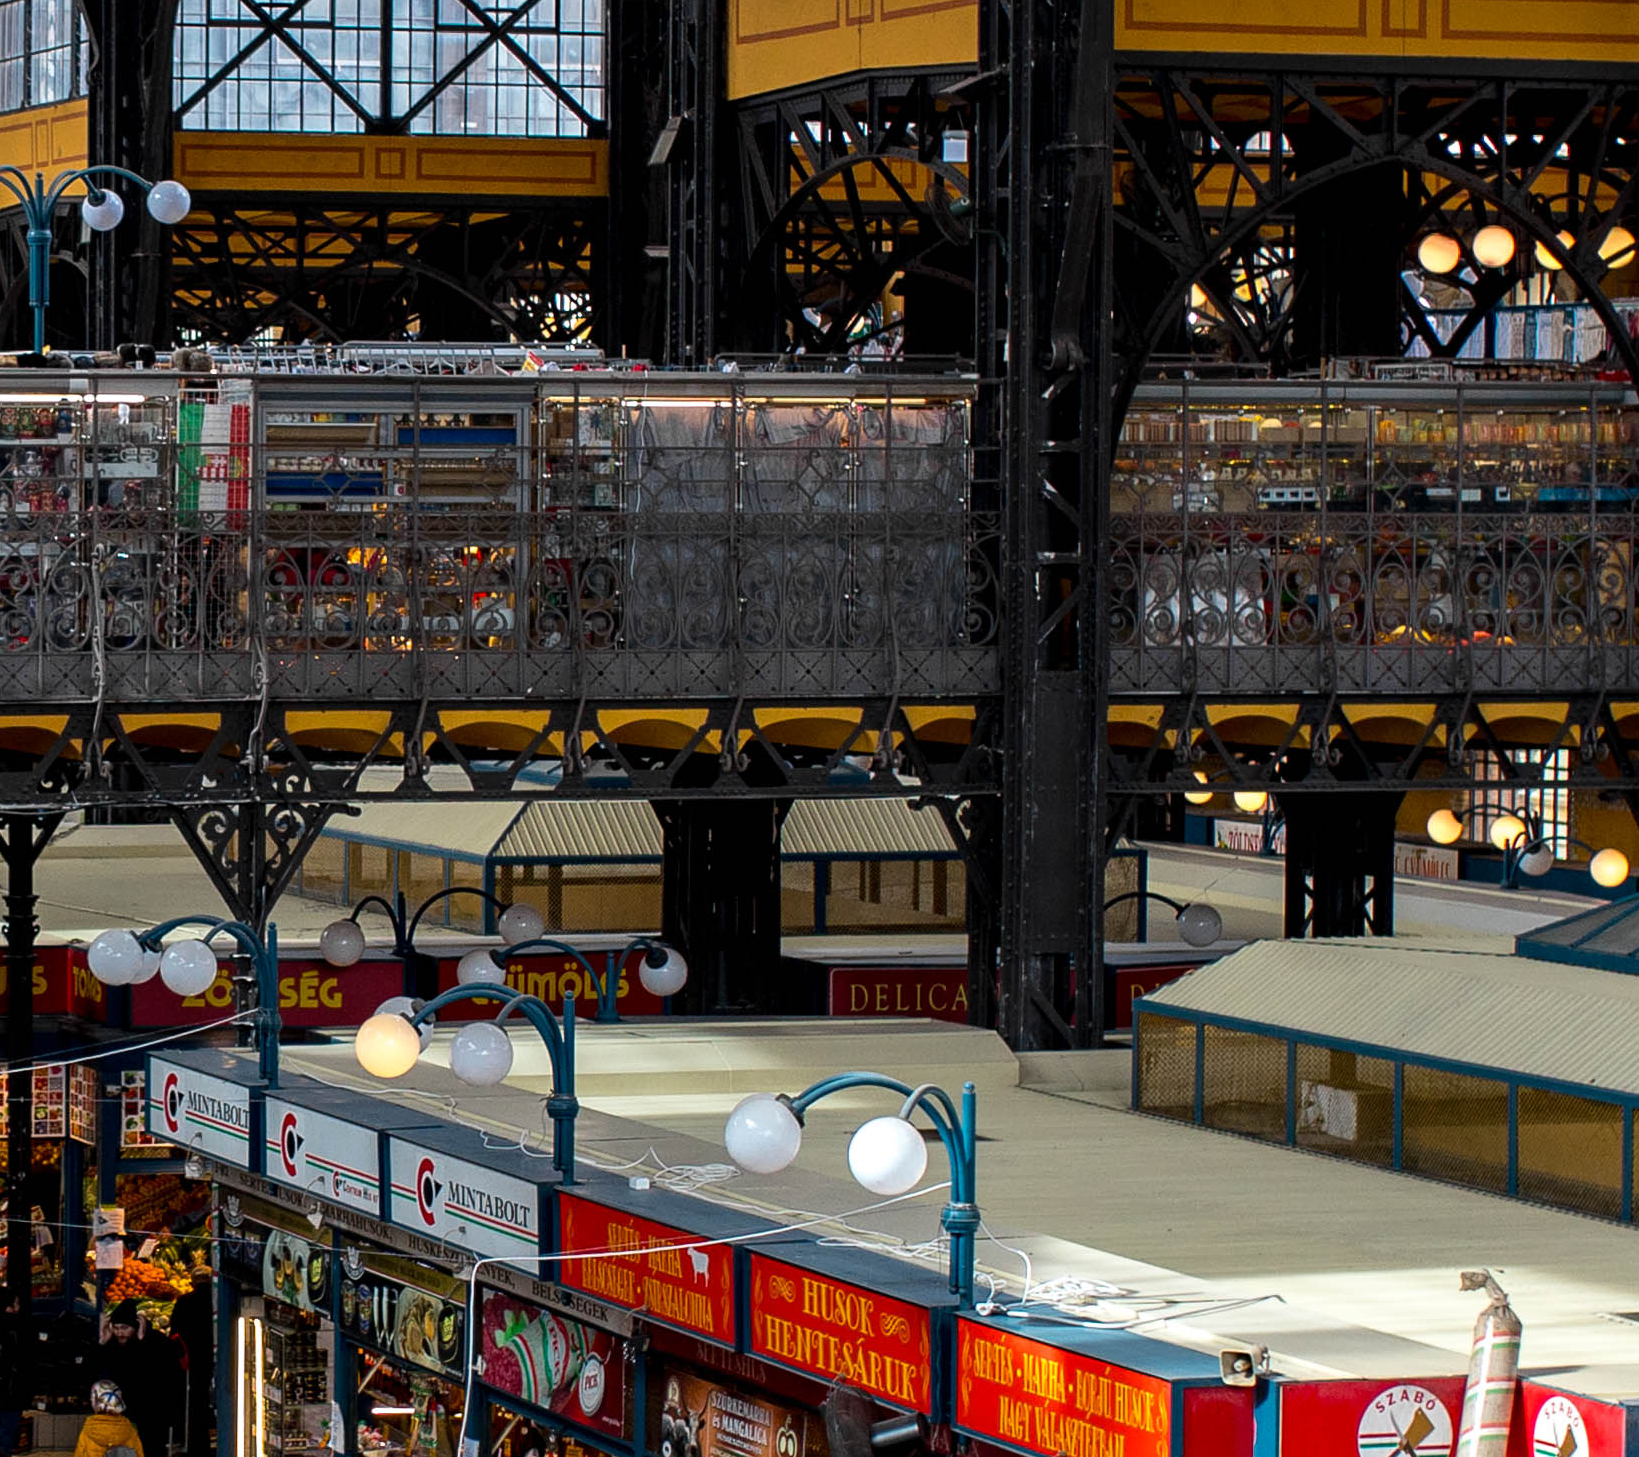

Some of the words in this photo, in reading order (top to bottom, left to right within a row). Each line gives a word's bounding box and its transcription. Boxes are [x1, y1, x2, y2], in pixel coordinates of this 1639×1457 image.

[447, 1179, 531, 1229] MINTABOLT
[802, 1276, 875, 1337] HUSOK
[764, 1313, 917, 1405] HENTESÁRUK
[1375, 1388, 1437, 1415] SZABÓ
